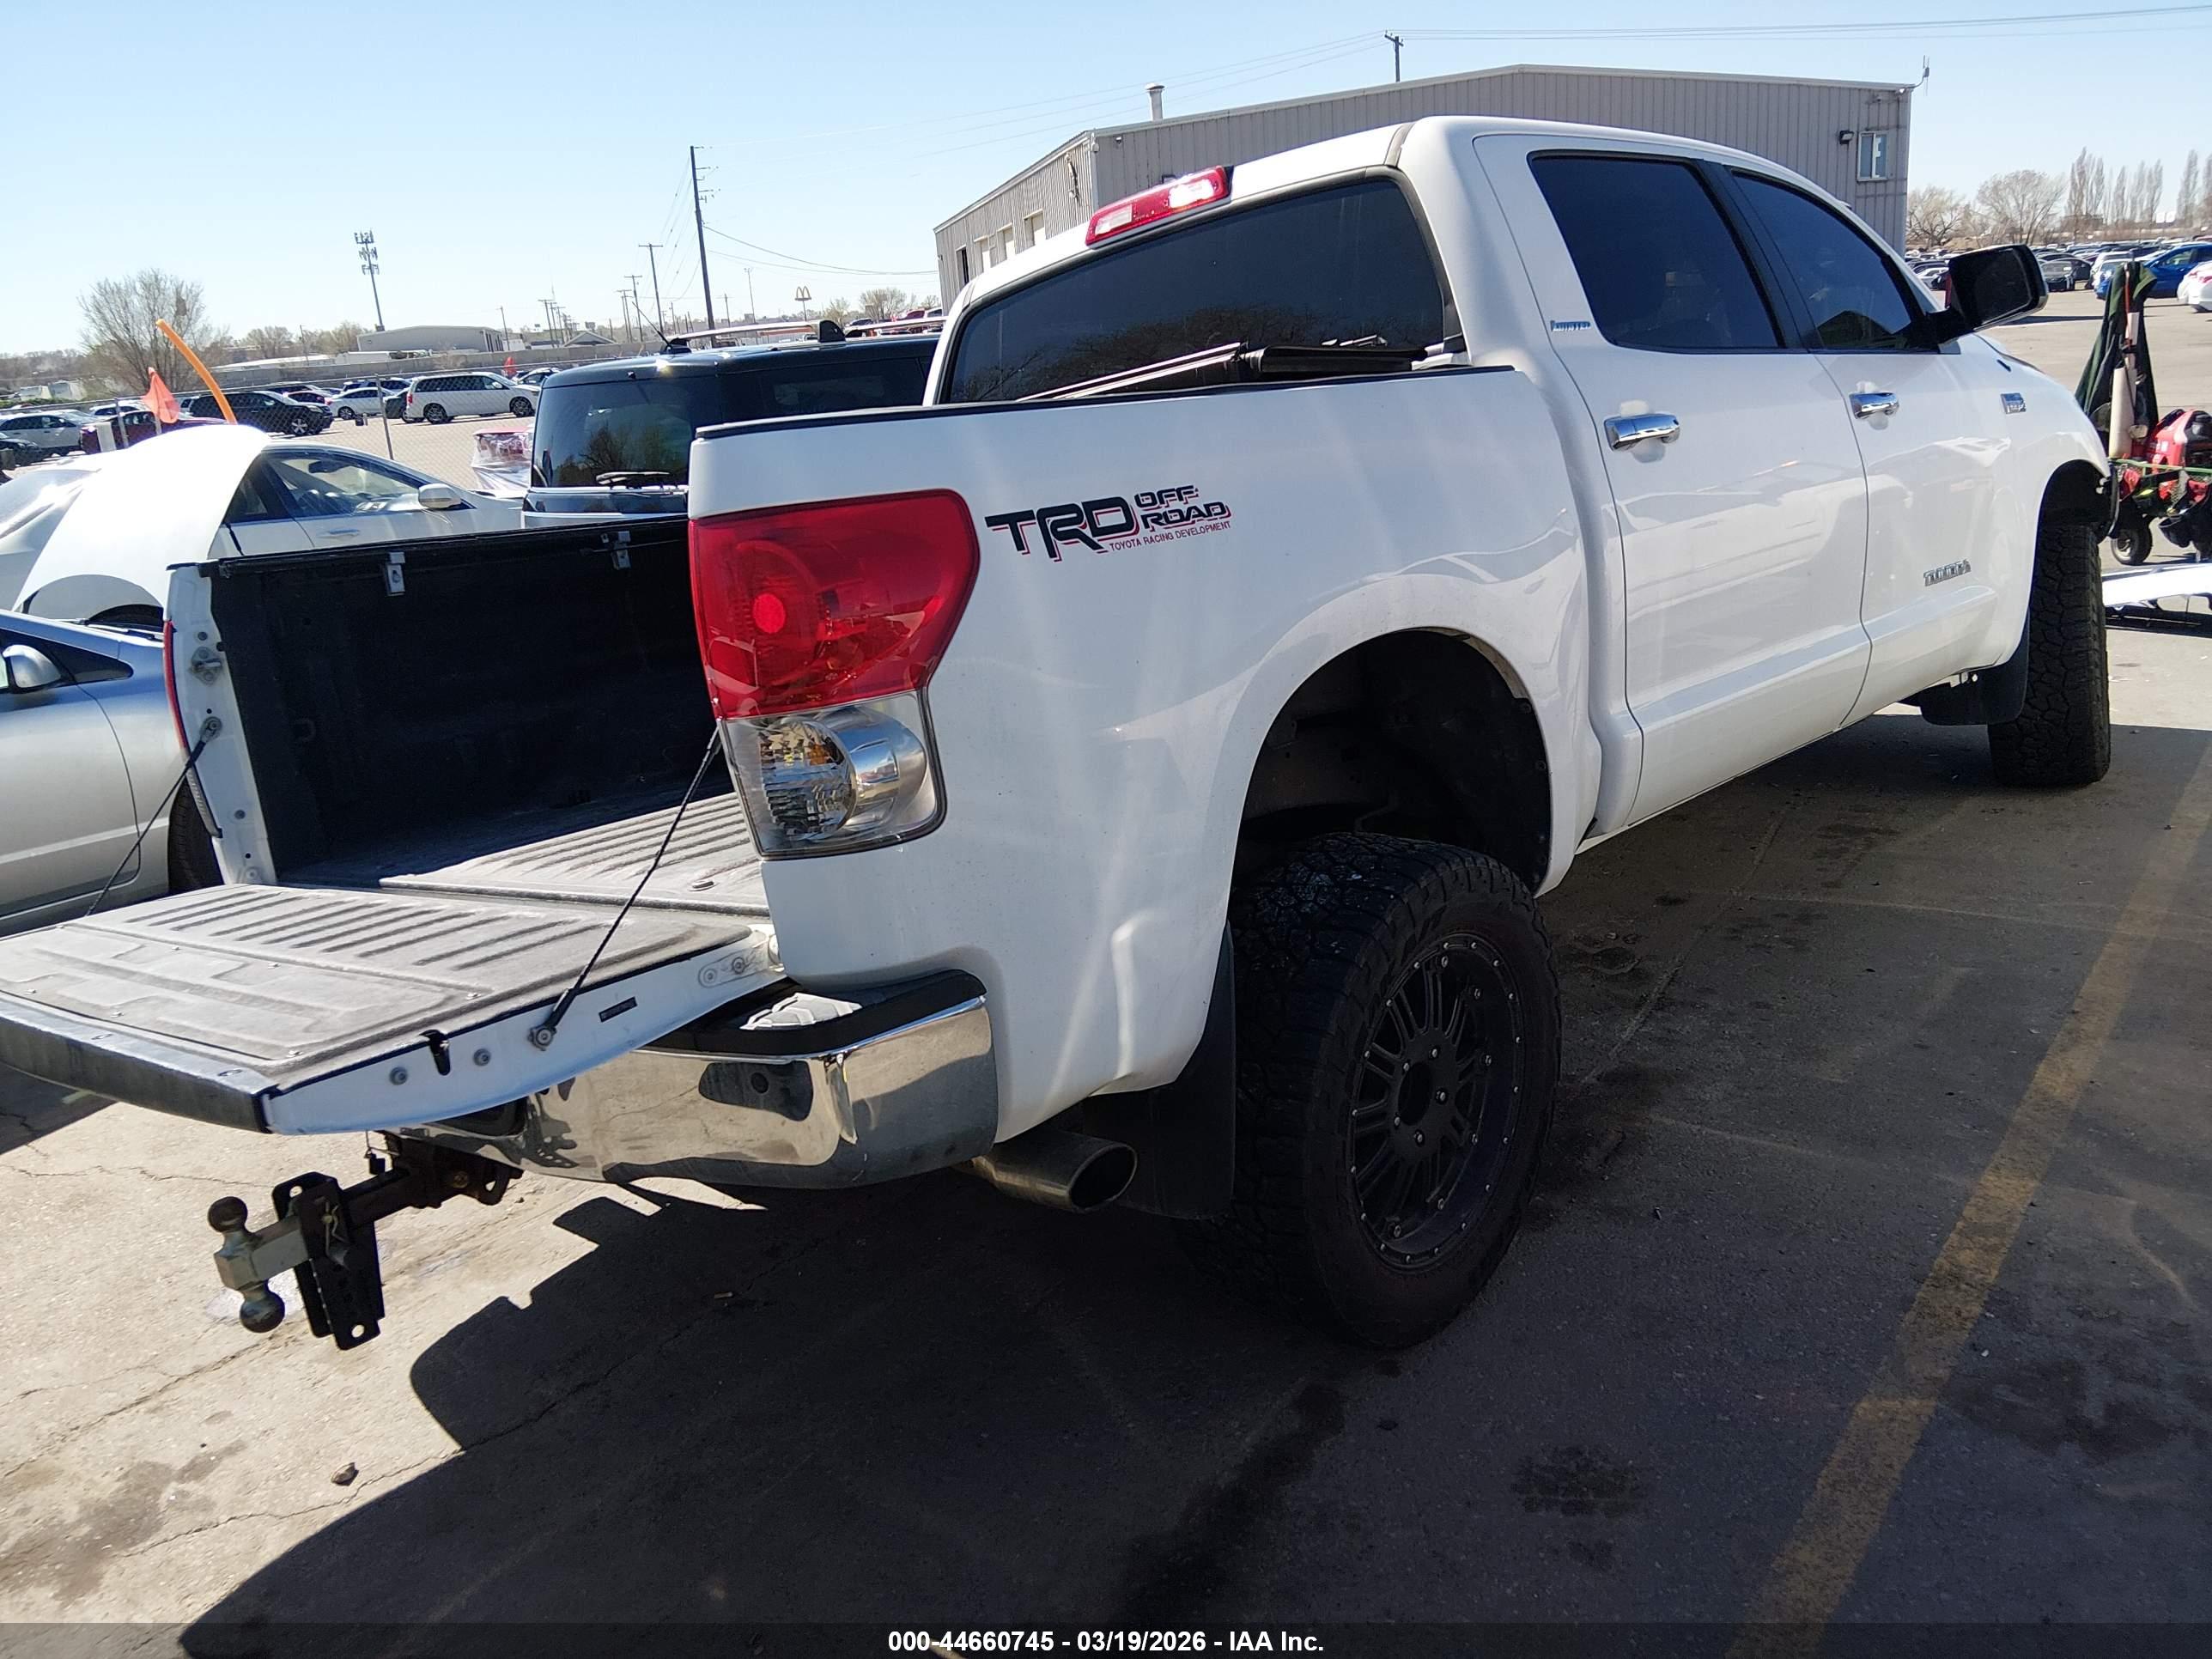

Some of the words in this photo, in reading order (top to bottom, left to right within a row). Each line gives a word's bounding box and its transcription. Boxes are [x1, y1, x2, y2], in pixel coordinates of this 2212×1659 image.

[1134, 485, 1199, 511] OFF
[984, 495, 1140, 562] TRD
[1140, 501, 1232, 532] ROAD
[1109, 536, 1143, 552] TOYOTA
[1143, 532, 1175, 546] RACING
[1176, 521, 1232, 540] DEVELOPMENT
